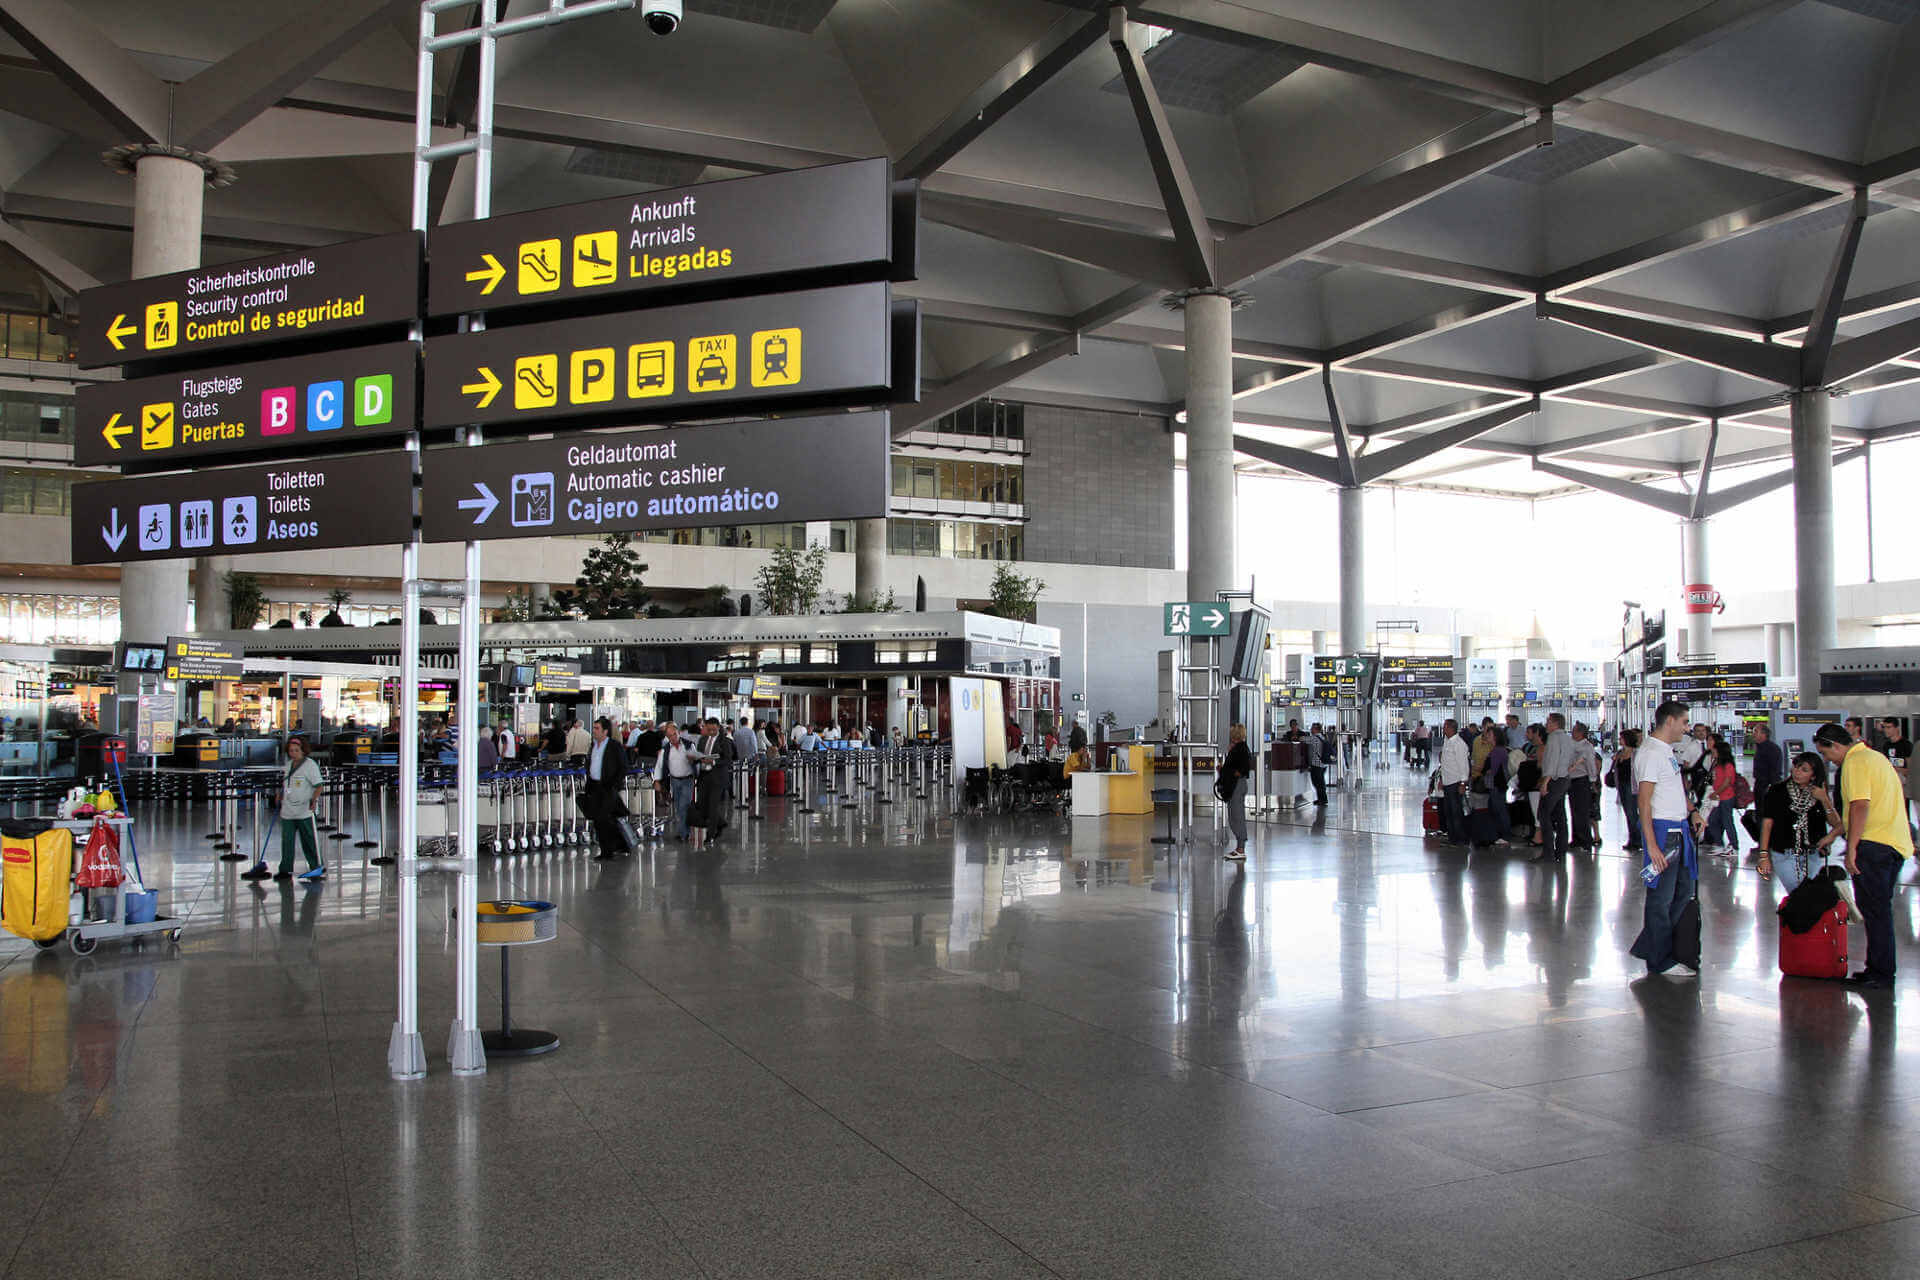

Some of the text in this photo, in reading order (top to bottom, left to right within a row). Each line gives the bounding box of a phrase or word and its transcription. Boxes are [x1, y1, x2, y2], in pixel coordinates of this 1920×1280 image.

[630, 196, 696, 224] Ankunft
[630, 222, 696, 249] Arrivals
[630, 247, 732, 279] Llegadas
[187, 259, 316, 295] Sicherheitskontrolle
[187, 286, 288, 317] Security control
[186, 295, 365, 341] Control de seguridad
[698, 339, 728, 353] TAXI
[183, 376, 243, 398] Flugsteige
[582, 358, 605, 394] P
[183, 401, 219, 419] Gates
[271, 384, 383, 428] B C D
[182, 422, 245, 444] Puertas
[567, 440, 677, 467] Geldautomat
[267, 472, 325, 491] Toiletten
[567, 463, 725, 493] Automatic cashier
[267, 496, 311, 514] Toilets
[567, 487, 779, 525] Cajero automático
[267, 519, 319, 540] Aseos
